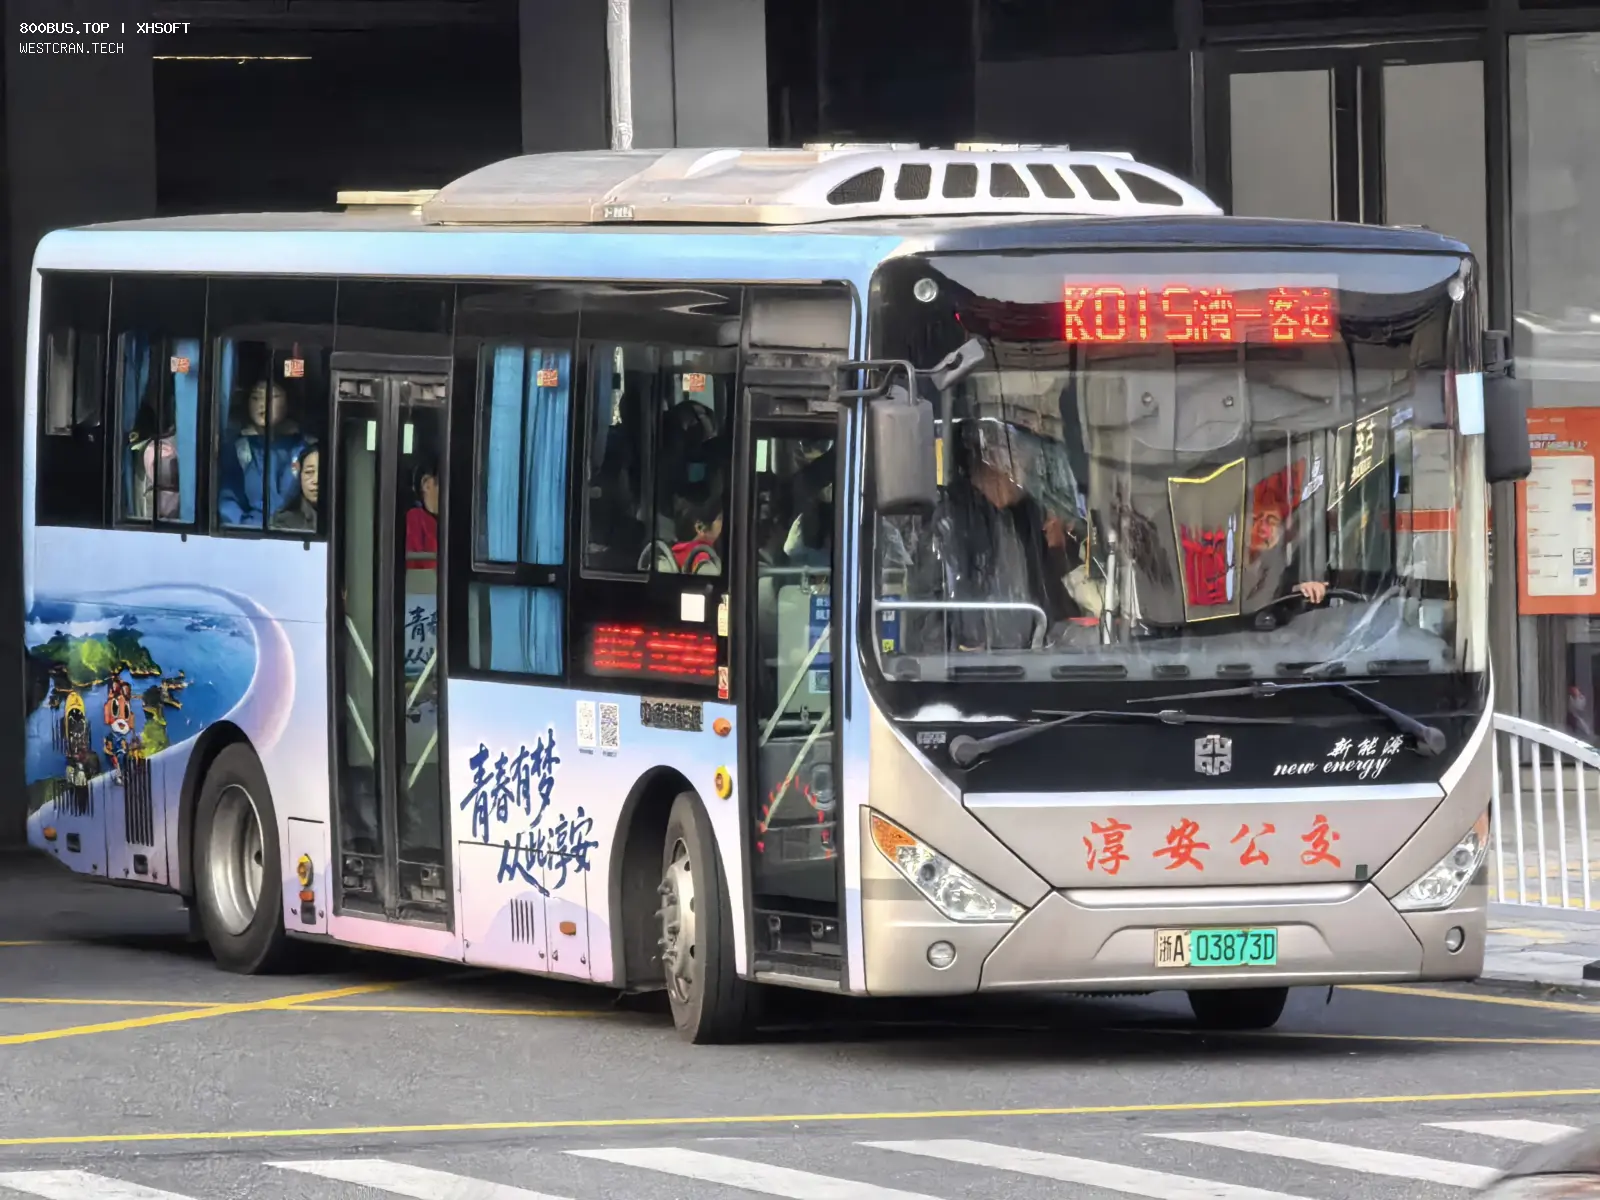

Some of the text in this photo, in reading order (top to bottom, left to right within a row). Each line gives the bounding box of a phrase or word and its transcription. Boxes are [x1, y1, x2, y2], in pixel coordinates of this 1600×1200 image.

[1273, 757, 1391, 780] new energy
[1327, 734, 1404, 759] 新能源
[460, 728, 561, 843] 青春有梦
[497, 806, 599, 897] 从此淳安
[1082, 814, 1341, 875] 淳安公交
